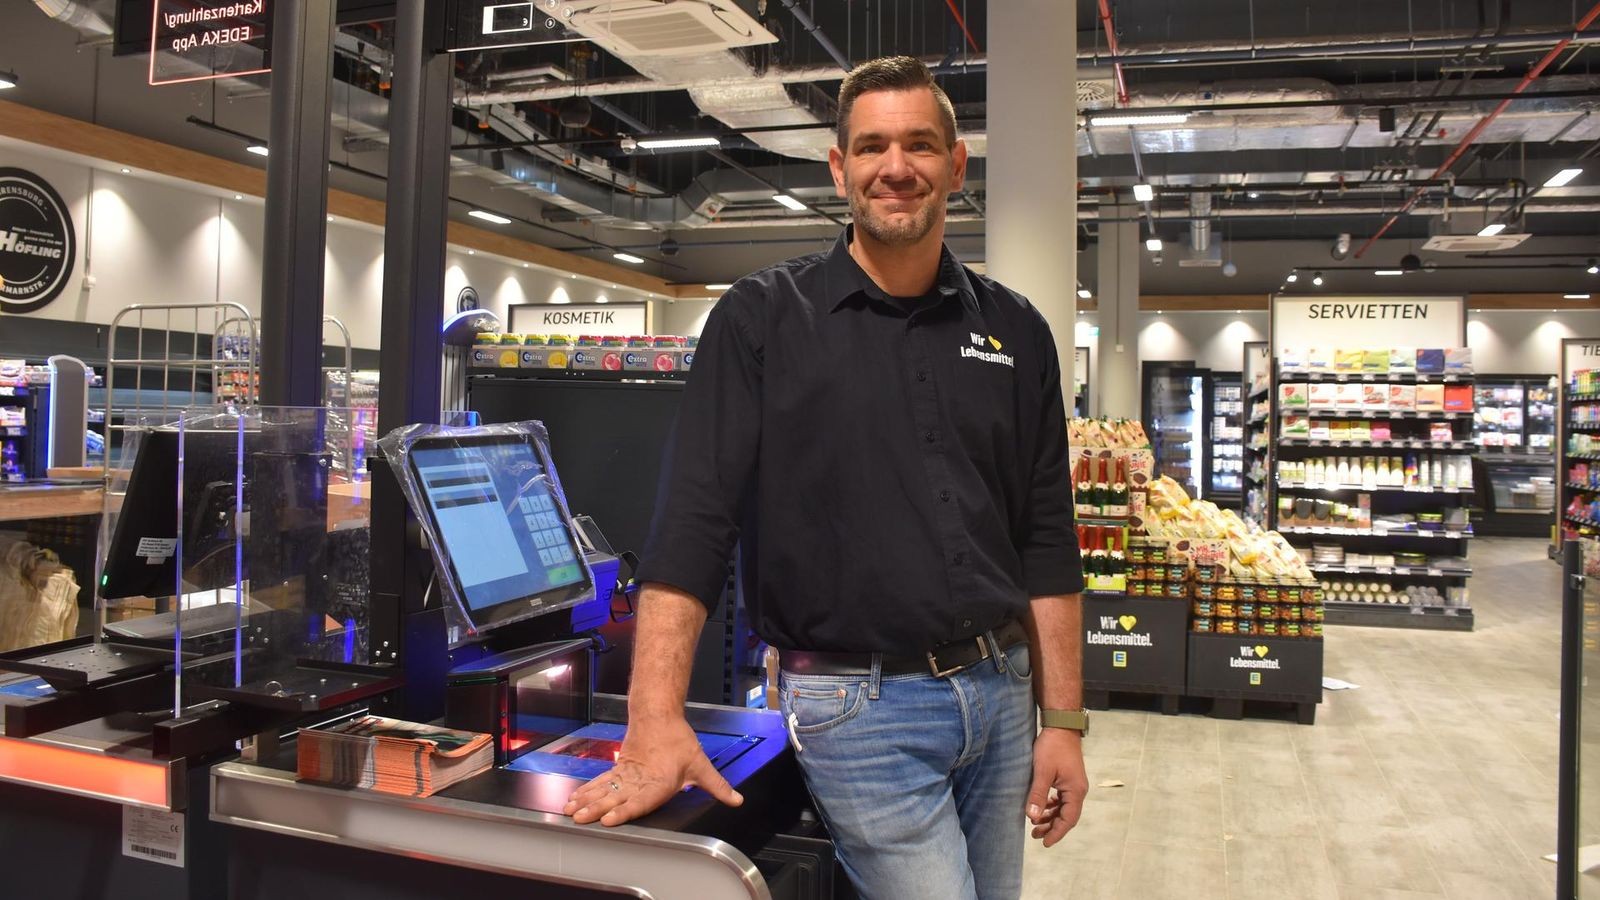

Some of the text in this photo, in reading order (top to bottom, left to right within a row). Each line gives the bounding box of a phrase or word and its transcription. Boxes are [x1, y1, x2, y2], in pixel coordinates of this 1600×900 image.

[0, 186, 44, 206] RENSBURG
[0, 229, 61, 259] HÖFLING
[543, 311, 615, 325] KOSMETIK
[1308, 303, 1429, 319] SERVIETTEN
[970, 332, 986, 346] Wir
[1100, 616, 1118, 630] Wir
[1087, 630, 1153, 647] Lebensmittel.
[1240, 646, 1255, 657] Wir
[1230, 657, 1281, 669] Lebensmittel.
